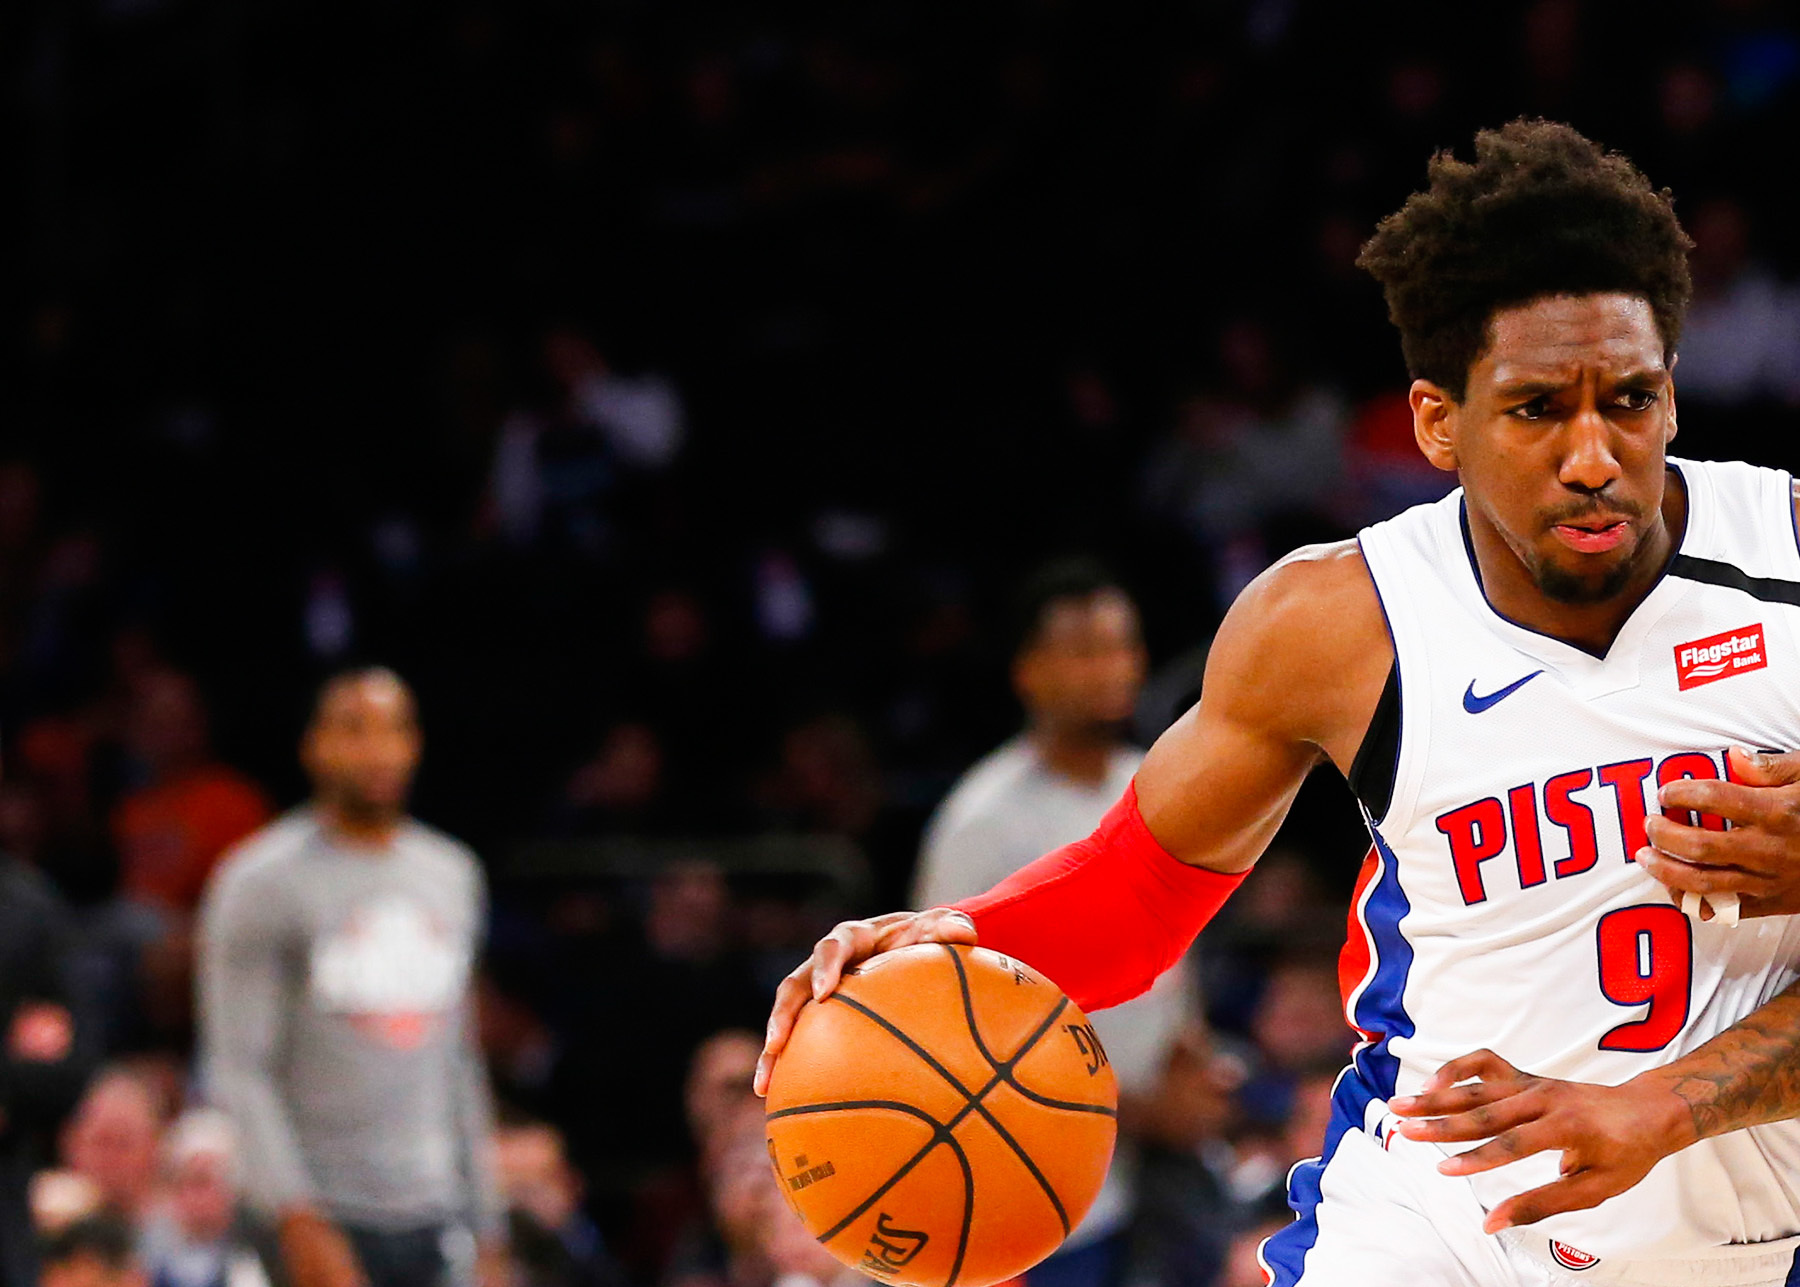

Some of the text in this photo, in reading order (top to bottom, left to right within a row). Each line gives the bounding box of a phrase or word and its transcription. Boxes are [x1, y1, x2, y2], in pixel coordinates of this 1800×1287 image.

[1680, 633, 1760, 668] Flagstar
[1732, 652, 1762, 669] Bank
[1597, 903, 1692, 1052] 9
